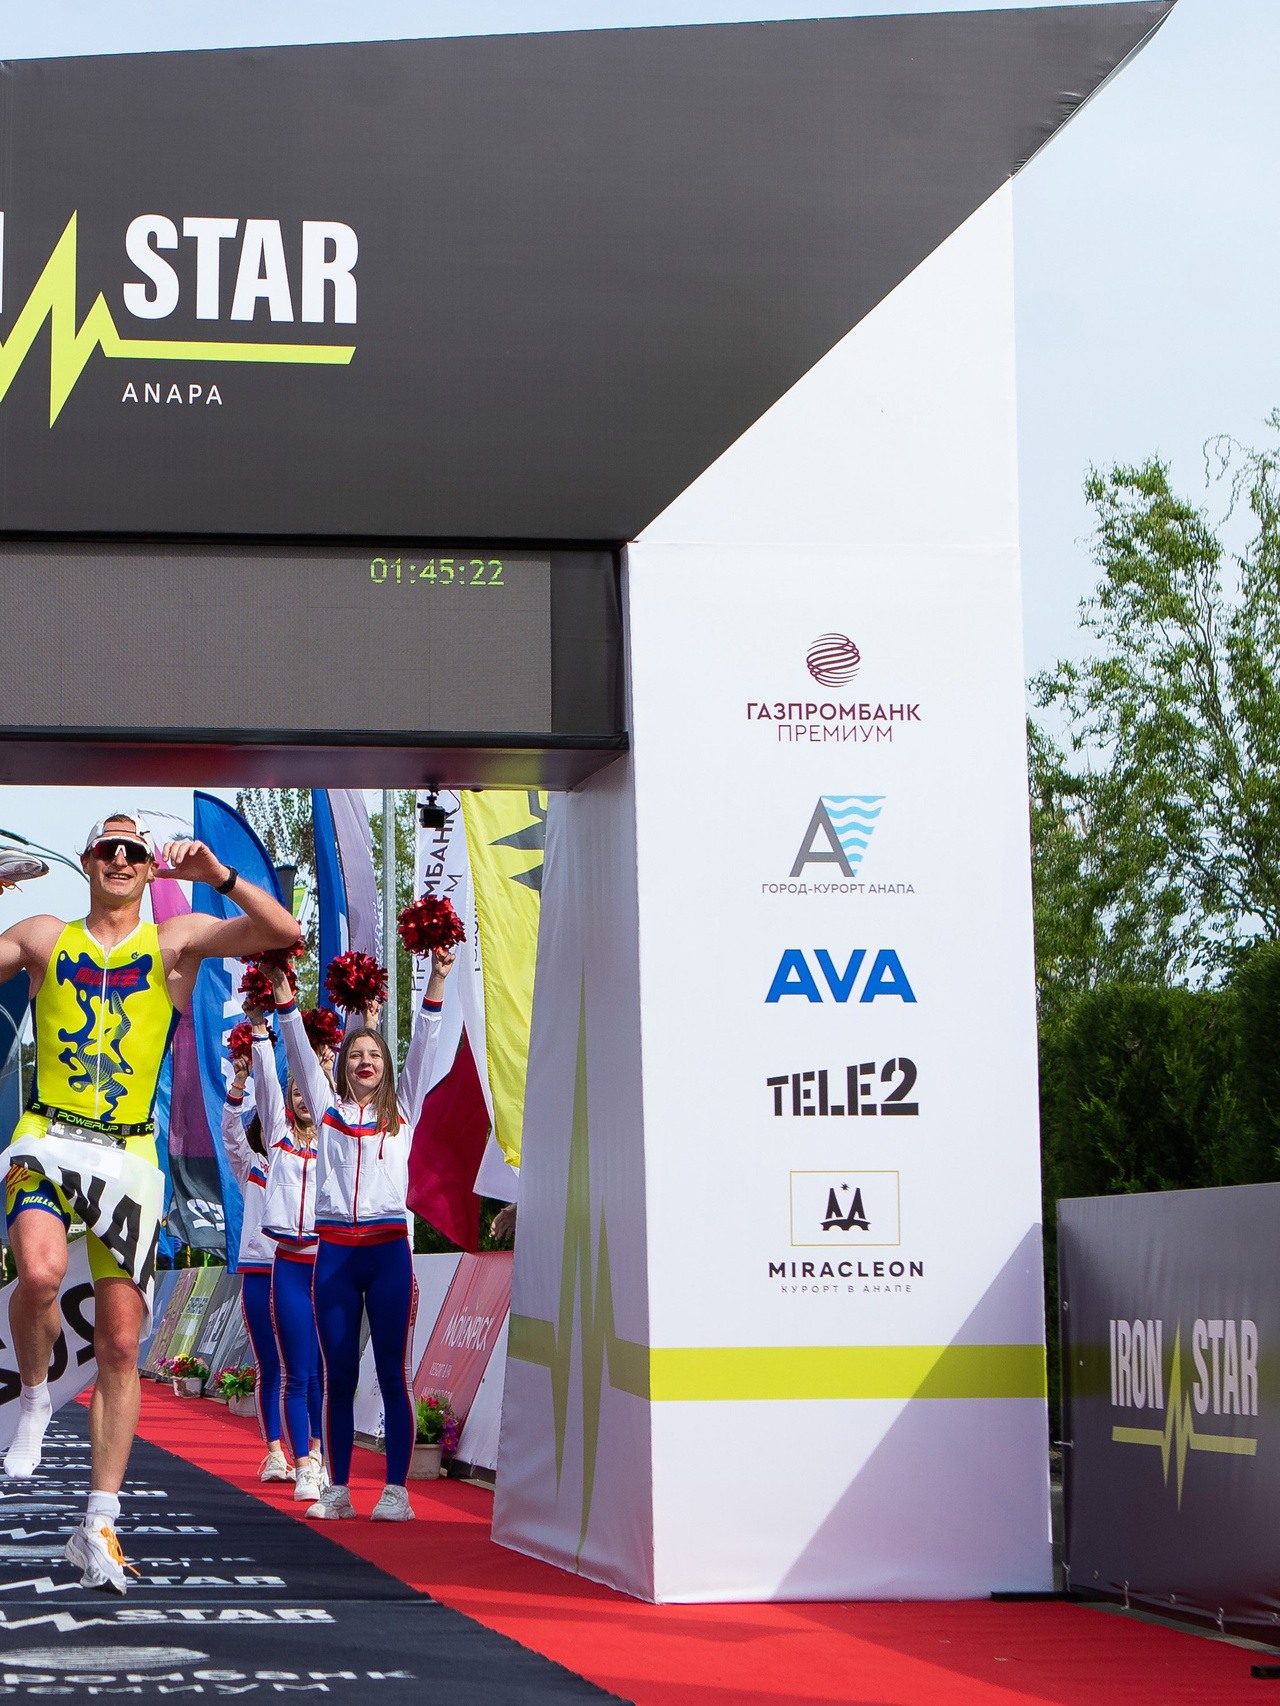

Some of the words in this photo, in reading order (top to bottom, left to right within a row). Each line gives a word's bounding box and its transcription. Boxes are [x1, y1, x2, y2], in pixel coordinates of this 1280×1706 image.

[123, 214, 358, 324] STAR
[121, 383, 222, 405] ANAPA
[370, 558, 504, 585] 01:45:22
[747, 703, 921, 721] ГАЗПРОМБАНК
[778, 725, 892, 742] ПРЕМИУМ
[761, 884, 865, 895] ГОРОД-КУРОРТ
[868, 884, 915, 894] АНАПА
[765, 949, 918, 1003] AVA
[766, 1057, 919, 1116] TELE2
[57, 1111, 119, 1132] POWERUP
[769, 1261, 923, 1277] MIRACLEON
[863, 1285, 912, 1293] АНАПЕ
[1110, 1319, 1164, 1409] IRON
[1192, 1319, 1259, 1417] STAR
[127, 1576, 286, 1586] TAR
[116, 1609, 334, 1621] STAR
